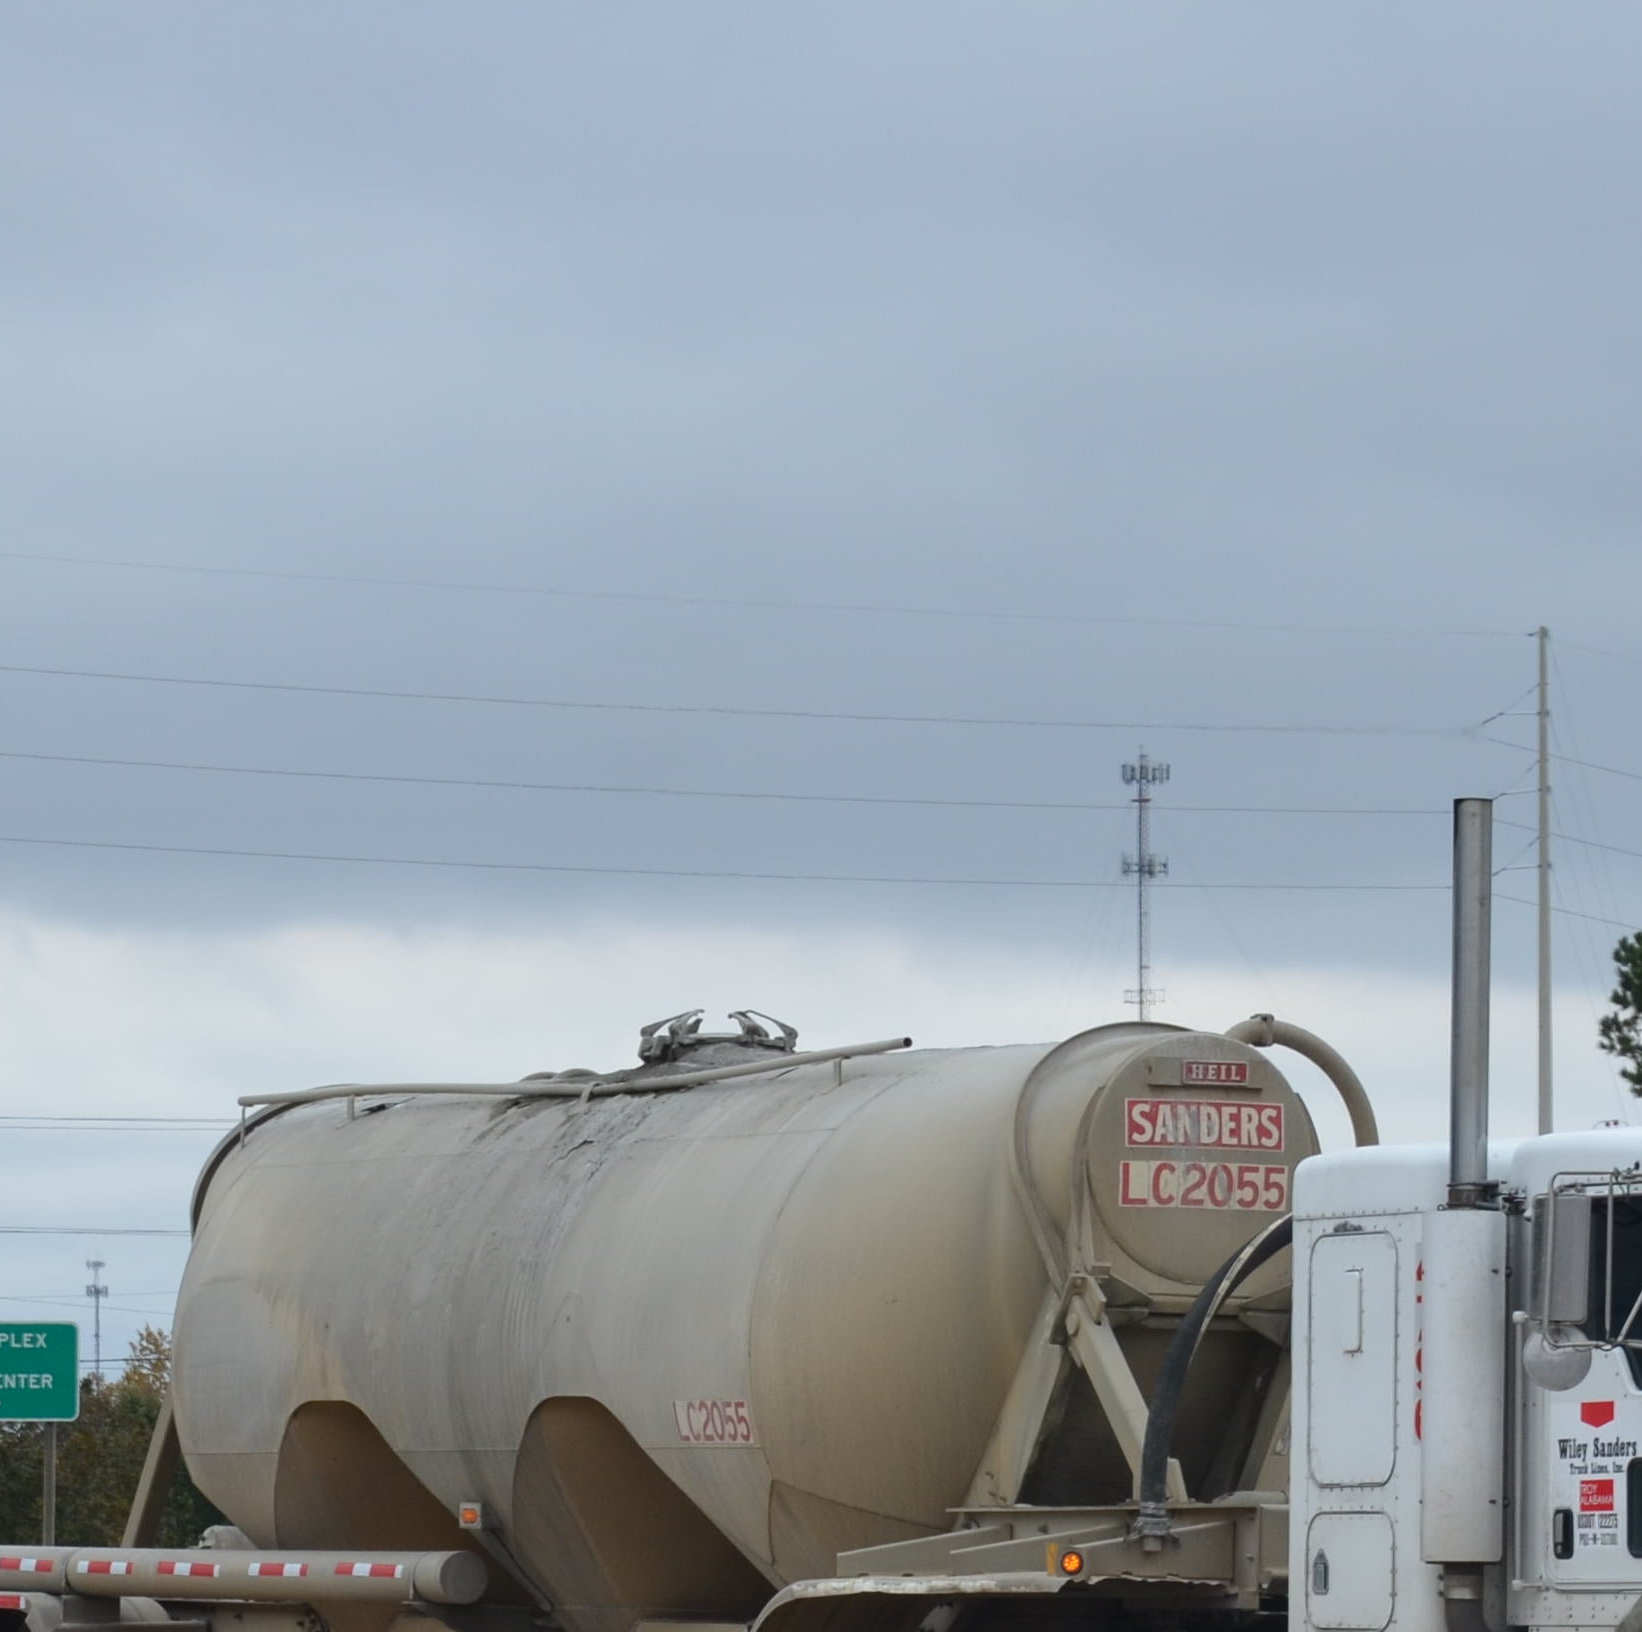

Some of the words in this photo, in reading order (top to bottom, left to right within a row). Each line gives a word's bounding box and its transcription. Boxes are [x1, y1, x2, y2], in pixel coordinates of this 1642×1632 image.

[1191, 1064, 1241, 1080] HEIL
[1131, 1102, 1280, 1147] SANDERS
[1120, 1162, 1286, 1210] LC2055
[672, 1400, 751, 1442] LC2055
[1558, 1438, 1588, 1462] Wiley
[1593, 1437, 1637, 1458] Sanders
